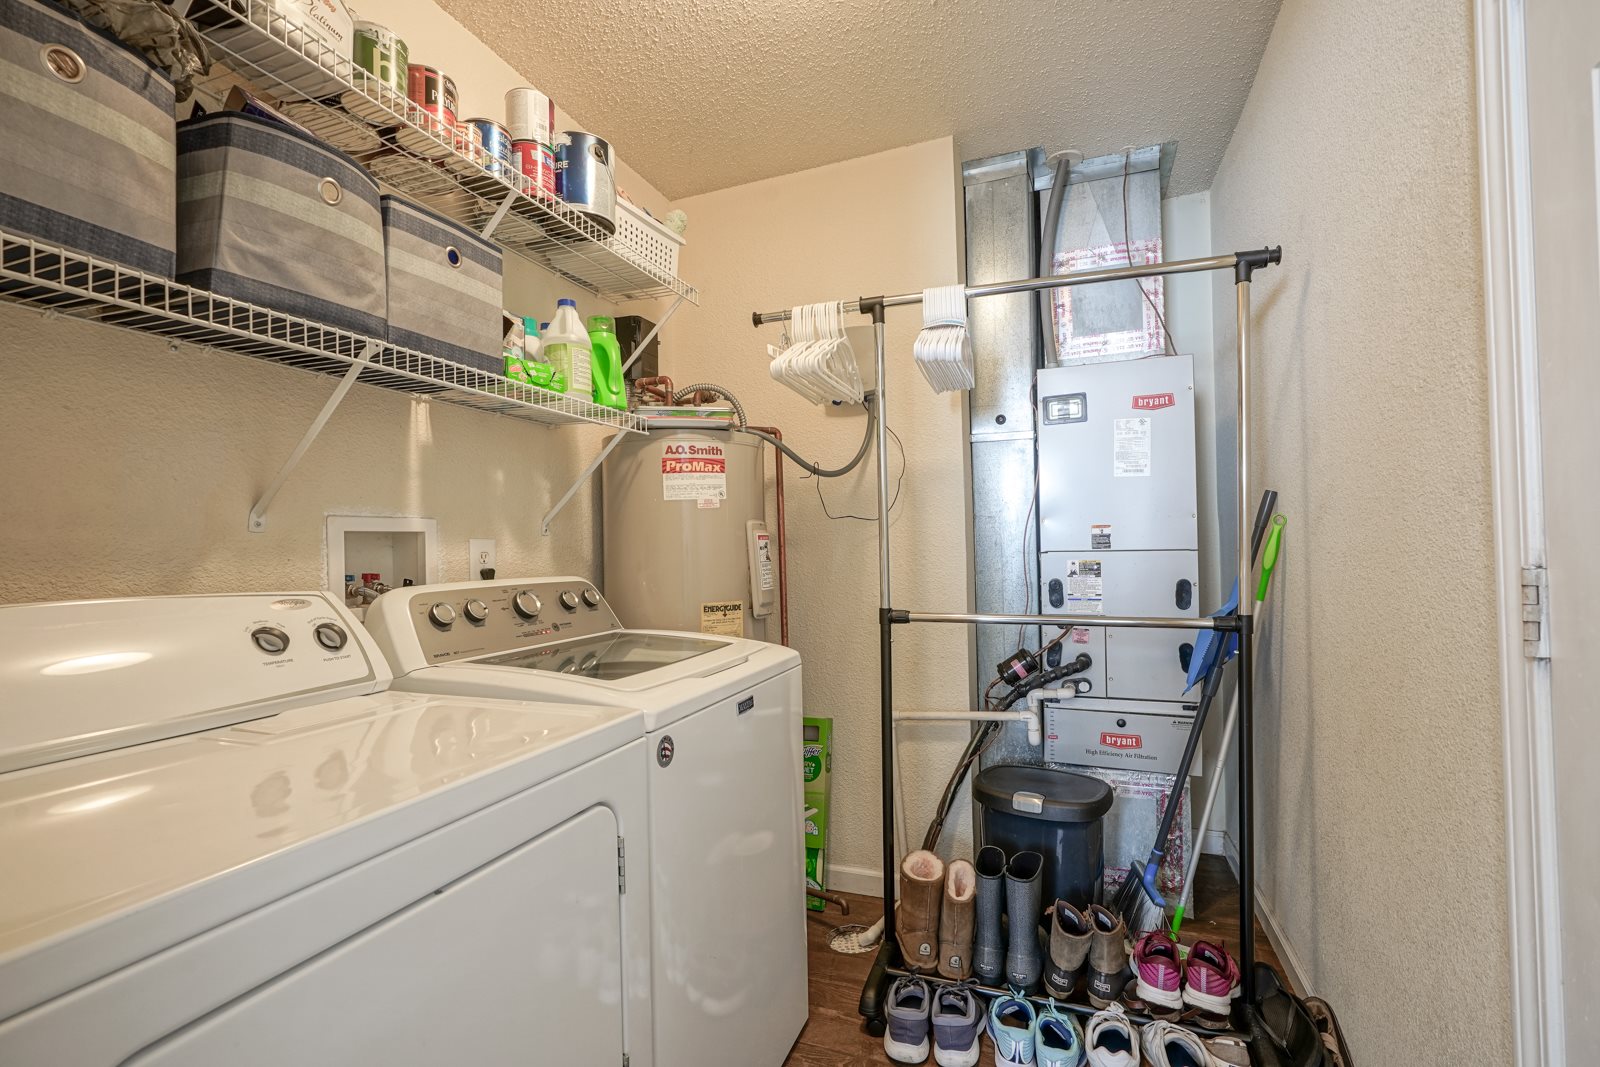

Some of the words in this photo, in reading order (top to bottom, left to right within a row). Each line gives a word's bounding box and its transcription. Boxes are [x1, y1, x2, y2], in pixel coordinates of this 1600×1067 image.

[1138, 394, 1170, 408] bryant
[665, 444, 688, 455] A.O.
[688, 444, 723, 456] Smith
[666, 460, 721, 472] ProMax
[1105, 735, 1137, 747] bryant
[1085, 748, 1099, 757] High
[1099, 749, 1123, 759] Efficiency
[1133, 752, 1158, 761] Filtration
